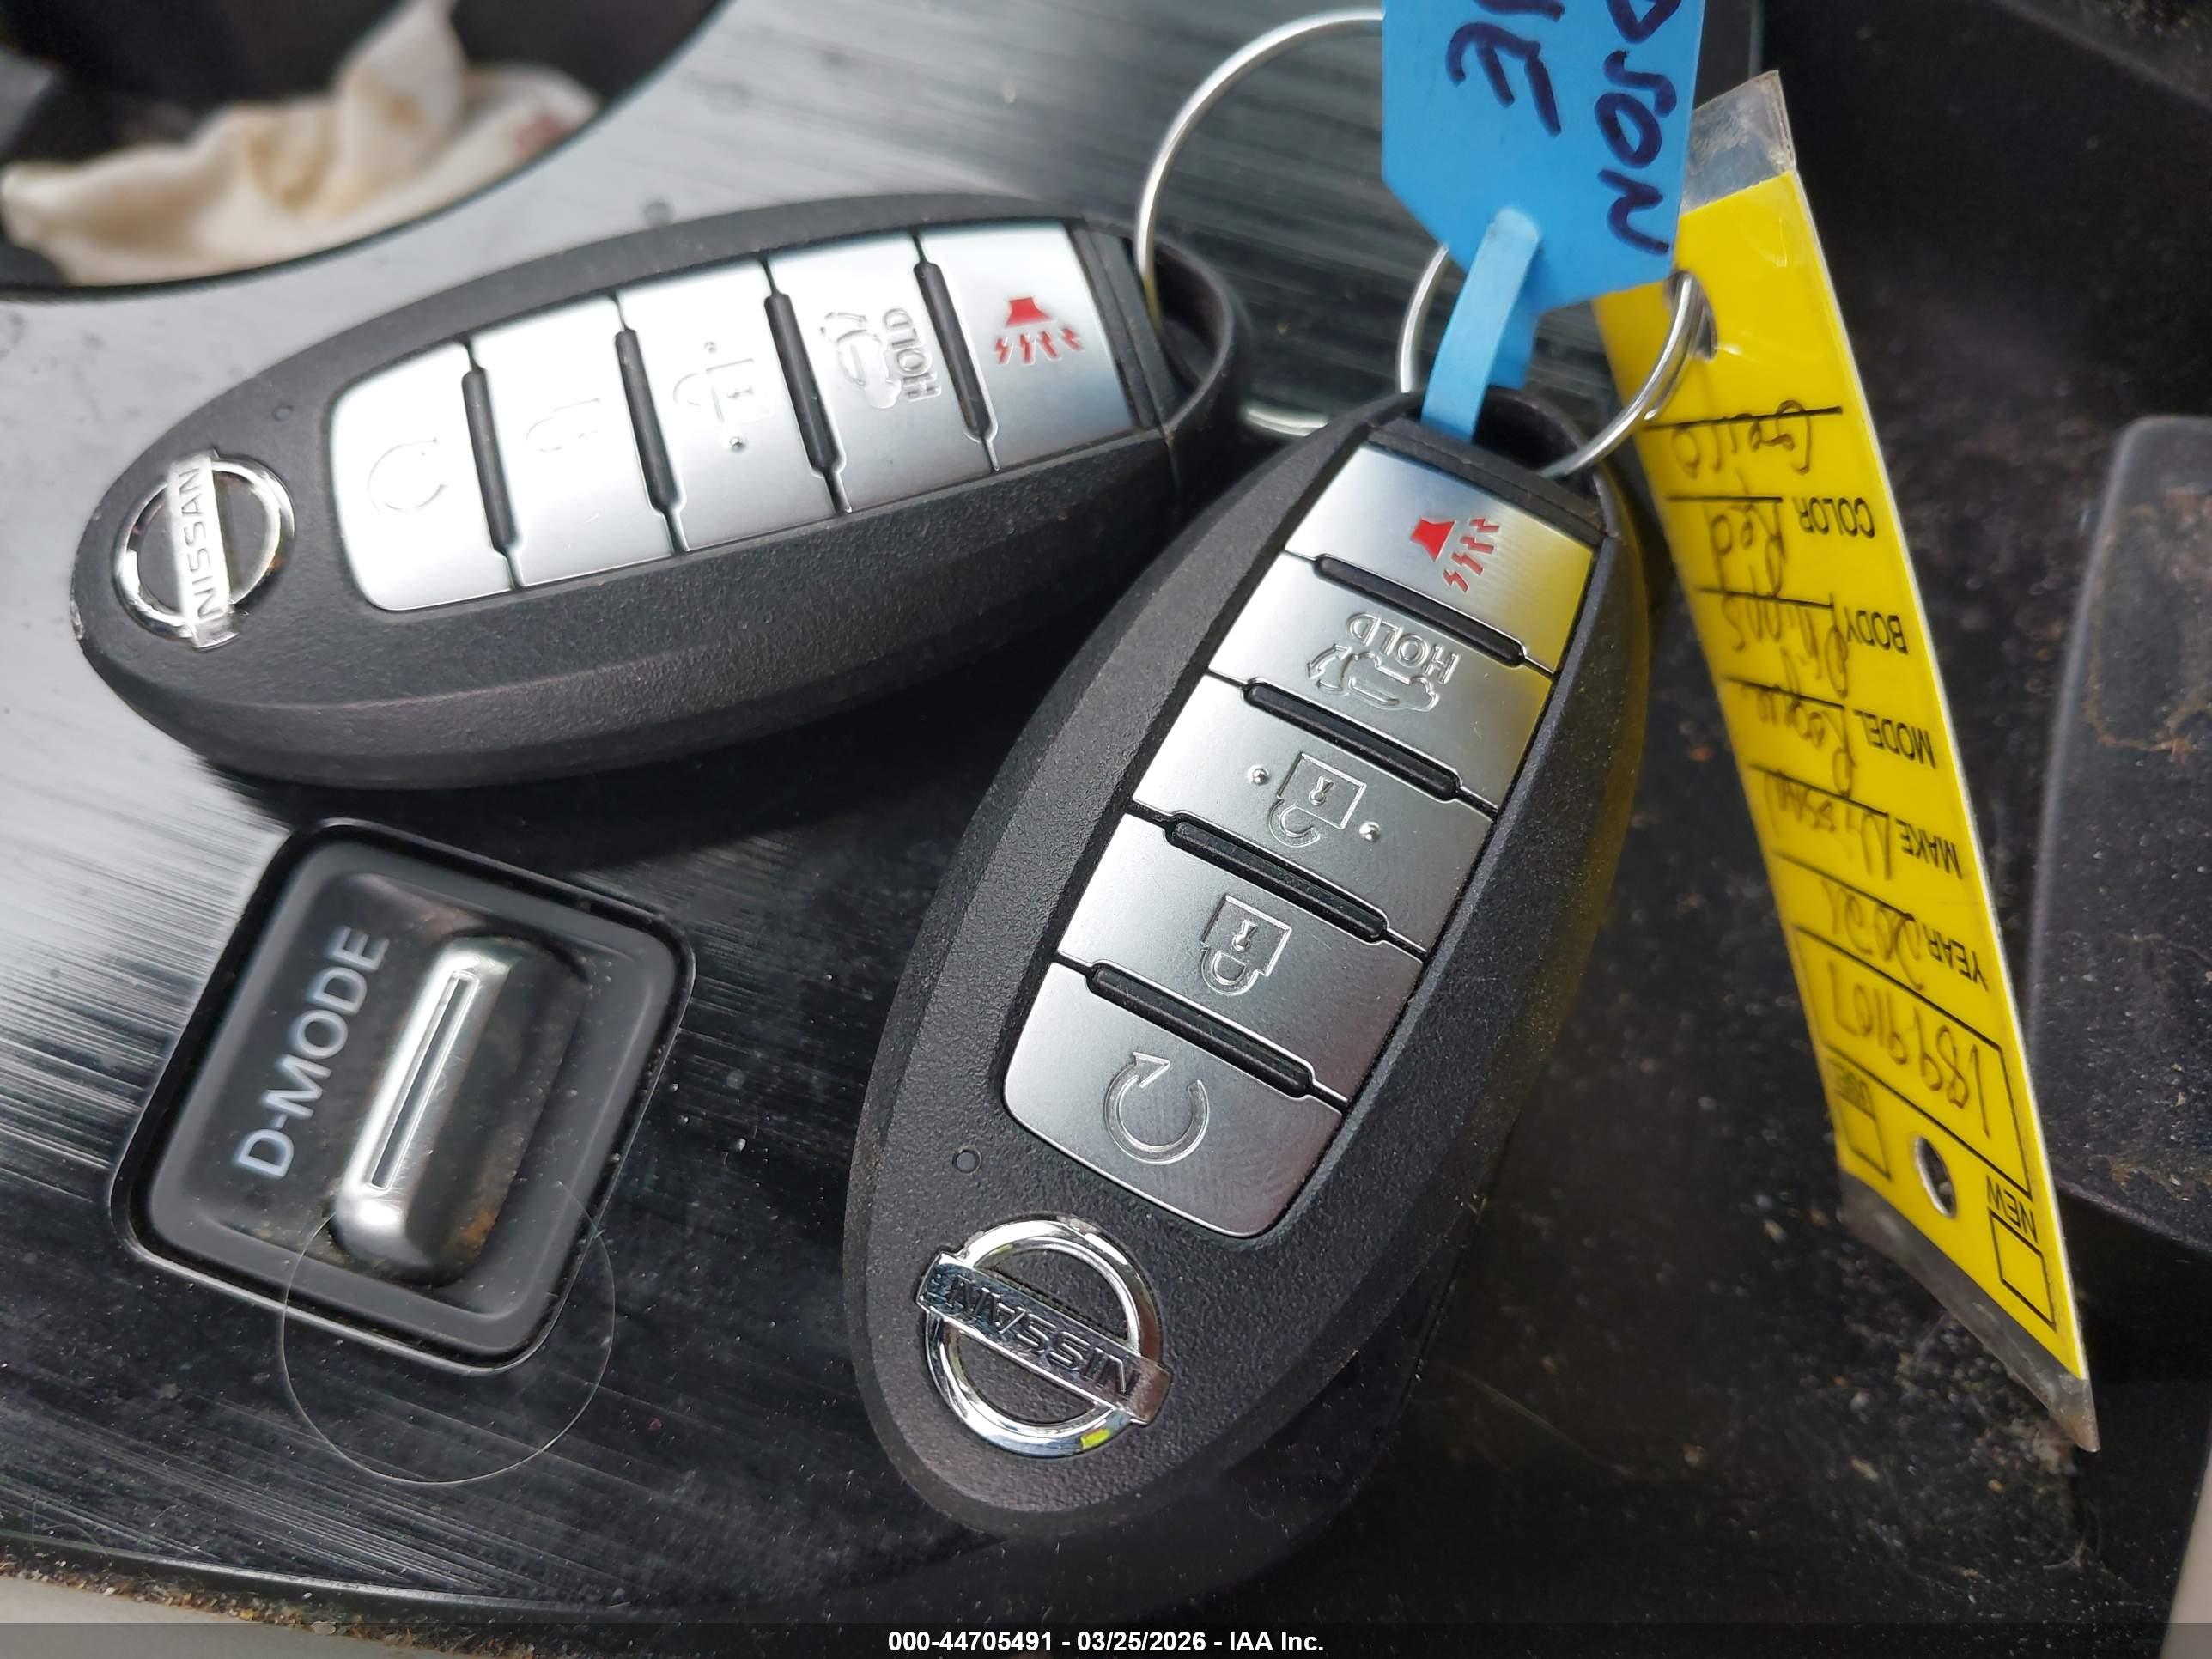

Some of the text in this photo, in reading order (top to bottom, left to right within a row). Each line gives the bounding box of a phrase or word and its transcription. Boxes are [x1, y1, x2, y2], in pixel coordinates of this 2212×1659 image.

[884, 308, 942, 402] HOLD
[178, 467, 225, 621] NISSAN
[1794, 497, 1875, 538] COLOR
[1347, 612, 1460, 684] HOLD
[1844, 606, 1909, 655] BODY
[1851, 708, 1936, 769] MODEL
[1895, 817, 1964, 879] MAKE
[1923, 923, 1989, 992] YEAR
[235, 925, 389, 1180] D-MODE
[1986, 1174, 2039, 1243] NEW
[944, 1275, 1141, 1398] NISSAN
